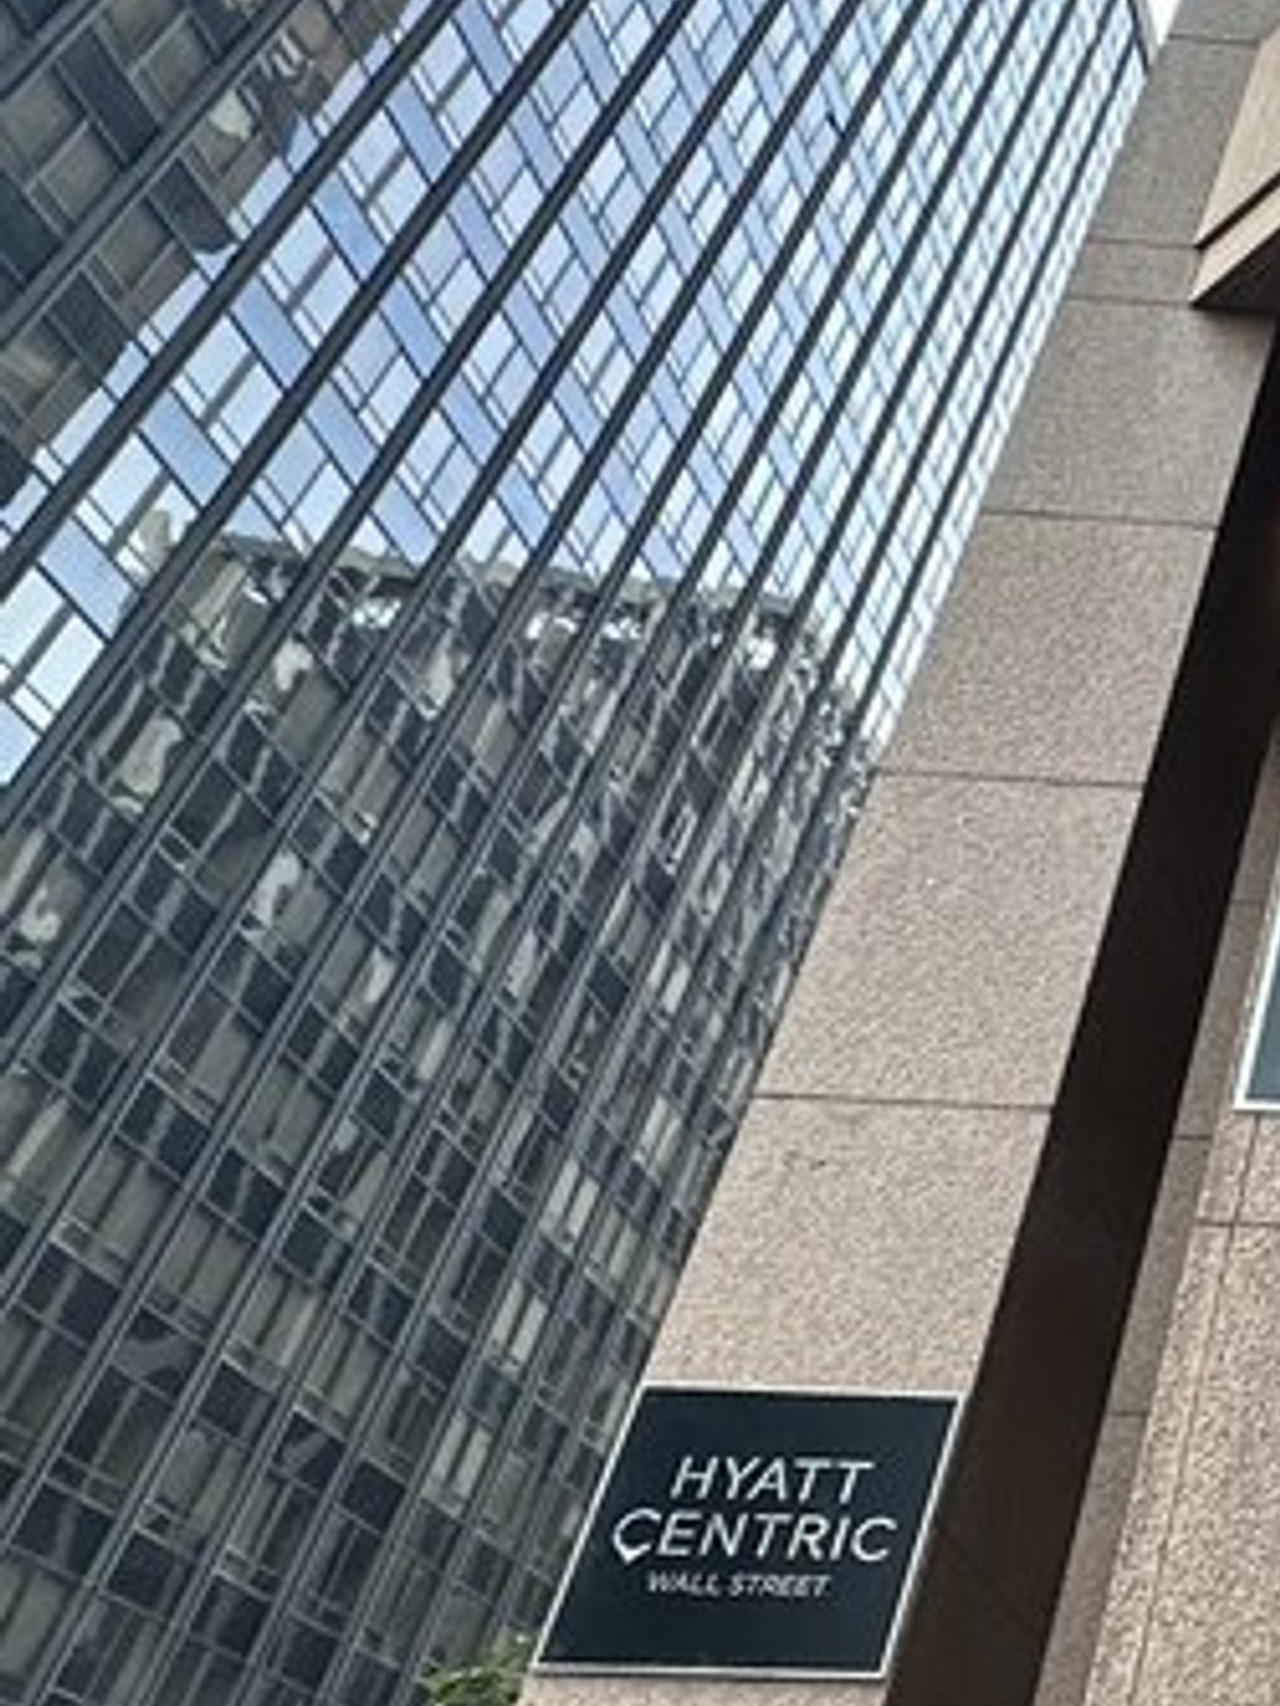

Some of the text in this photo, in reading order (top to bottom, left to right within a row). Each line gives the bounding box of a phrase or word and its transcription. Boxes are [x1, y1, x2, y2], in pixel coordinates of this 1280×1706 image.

[669, 1455, 874, 1504] HYATT
[613, 1508, 898, 1564] CENTRIC
[647, 1571, 832, 1598] WALL STREET
